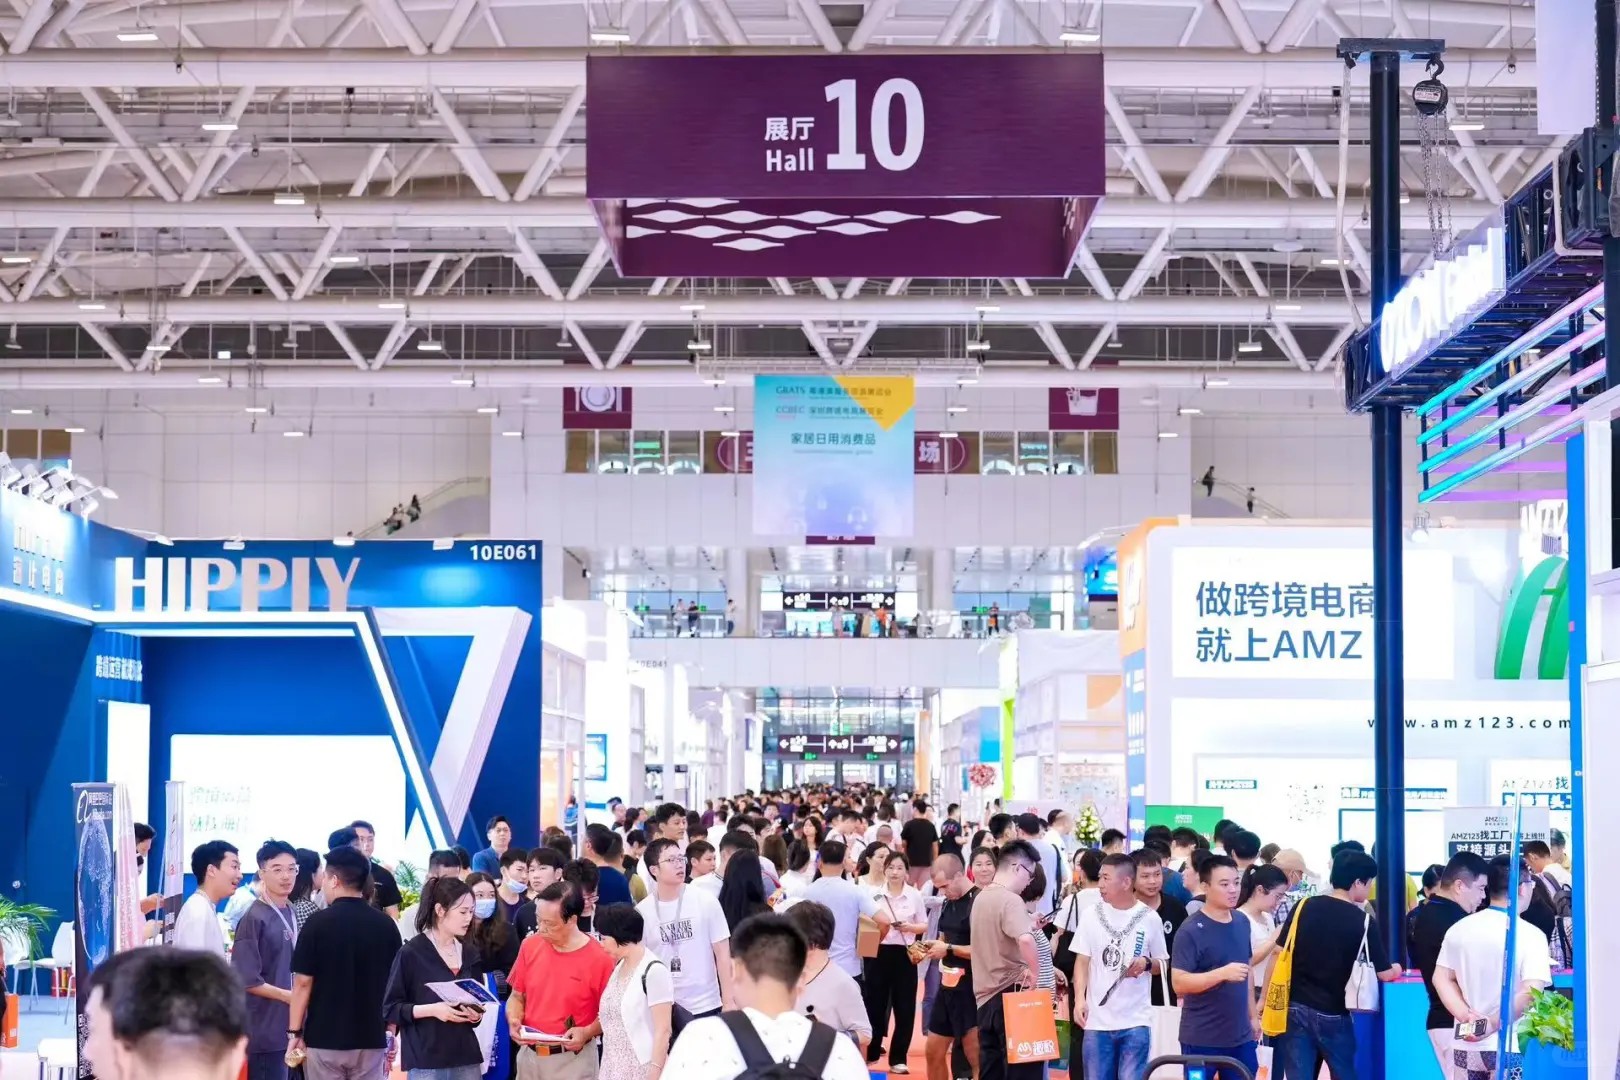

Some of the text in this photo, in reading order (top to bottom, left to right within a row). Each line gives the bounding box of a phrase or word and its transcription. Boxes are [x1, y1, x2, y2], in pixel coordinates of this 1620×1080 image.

[764, 116, 815, 141] 展厅
[824, 77, 925, 171] 10
[766, 147, 814, 172] Hall
[791, 432, 876, 445] 家居日用消费品
[470, 544, 536, 561] 10E061
[1195, 581, 1375, 618] 做跨境电商
